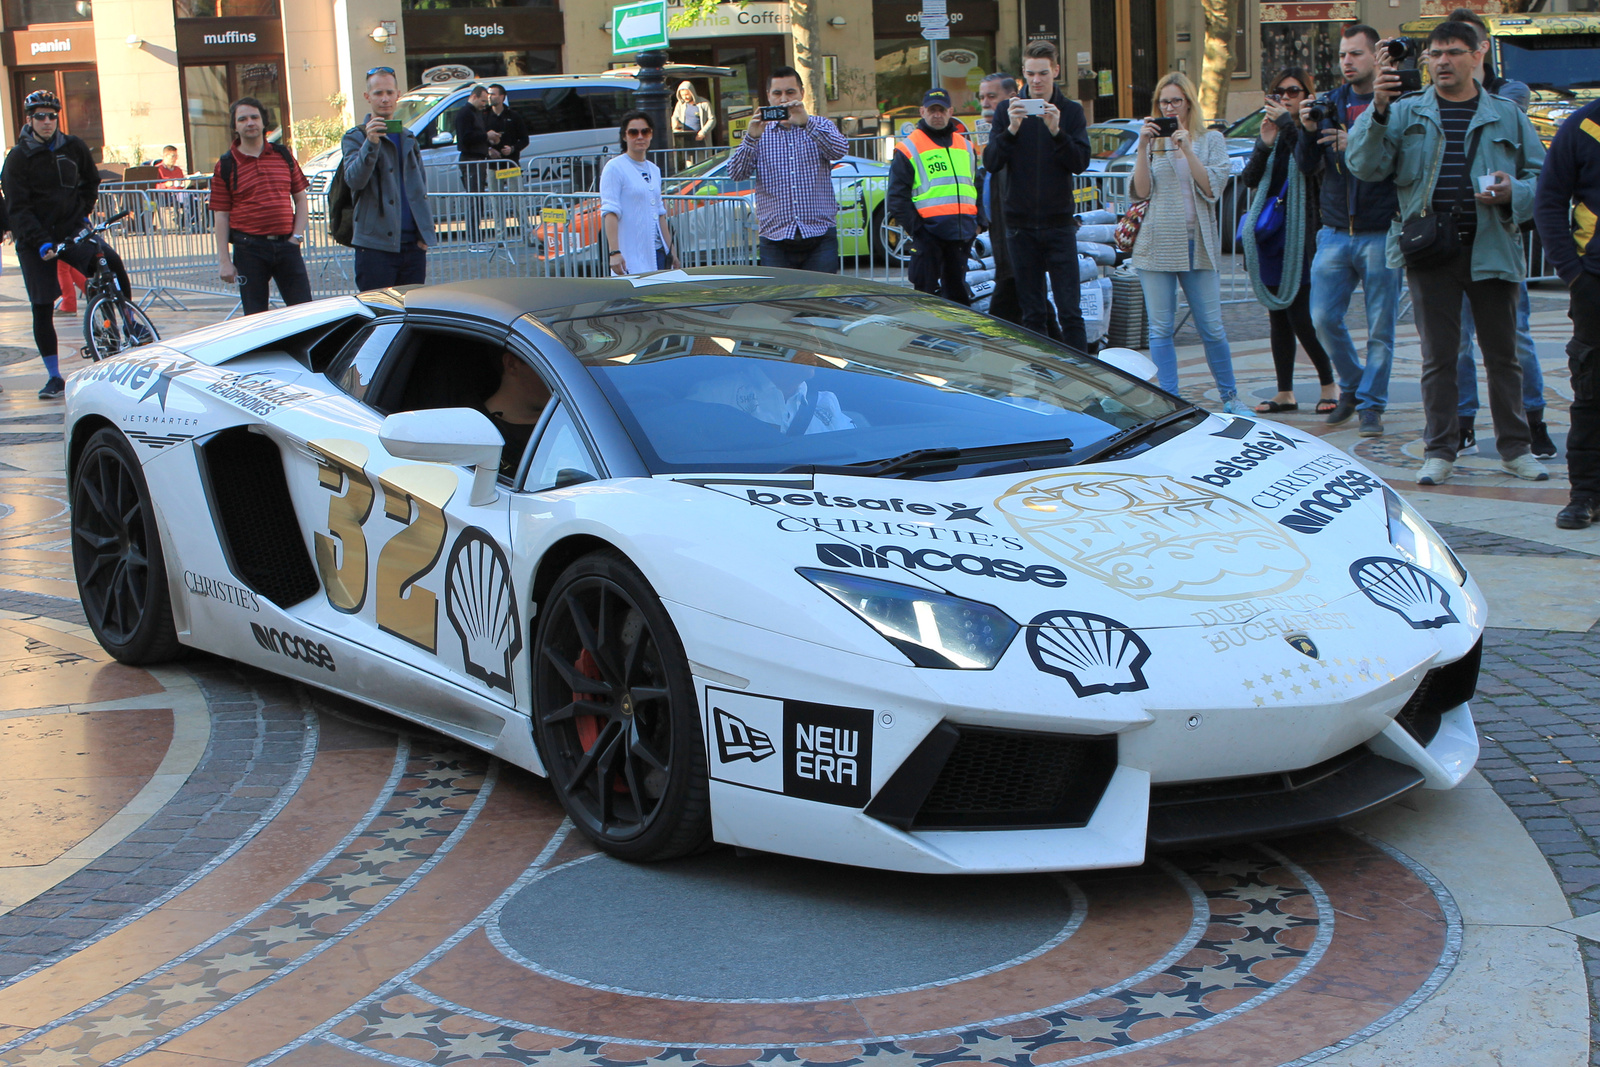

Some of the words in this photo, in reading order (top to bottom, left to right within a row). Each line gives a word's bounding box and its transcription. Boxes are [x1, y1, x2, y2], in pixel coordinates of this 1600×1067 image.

[464, 23, 504, 37] bagels
[737, 11, 791, 25] Coffee
[950, 13, 963, 23] go
[31, 38, 71, 55] panini
[203, 31, 256, 45] muffins
[928, 161, 947, 174] 396
[206, 381, 277, 416] HEADPHONES
[122, 414, 199, 426] JETSMARTER
[1191, 440, 1285, 488] betsafe
[1251, 453, 1352, 509] CHRISTIE'S
[746, 489, 937, 516] betsafe
[1292, 469, 1383, 525] incase
[307, 437, 459, 656] 32
[776, 516, 1024, 552] CHRISTIE'S
[860, 543, 1068, 588] incase
[184, 569, 261, 613] CHRISTIE'S
[1190, 597, 1294, 628] DUBLIN
[1294, 593, 1326, 612] TO
[262, 624, 336, 672] incase
[1202, 612, 1356, 653] BUCHAREST
[796, 722, 859, 757] NEW
[796, 751, 858, 786] ERA
